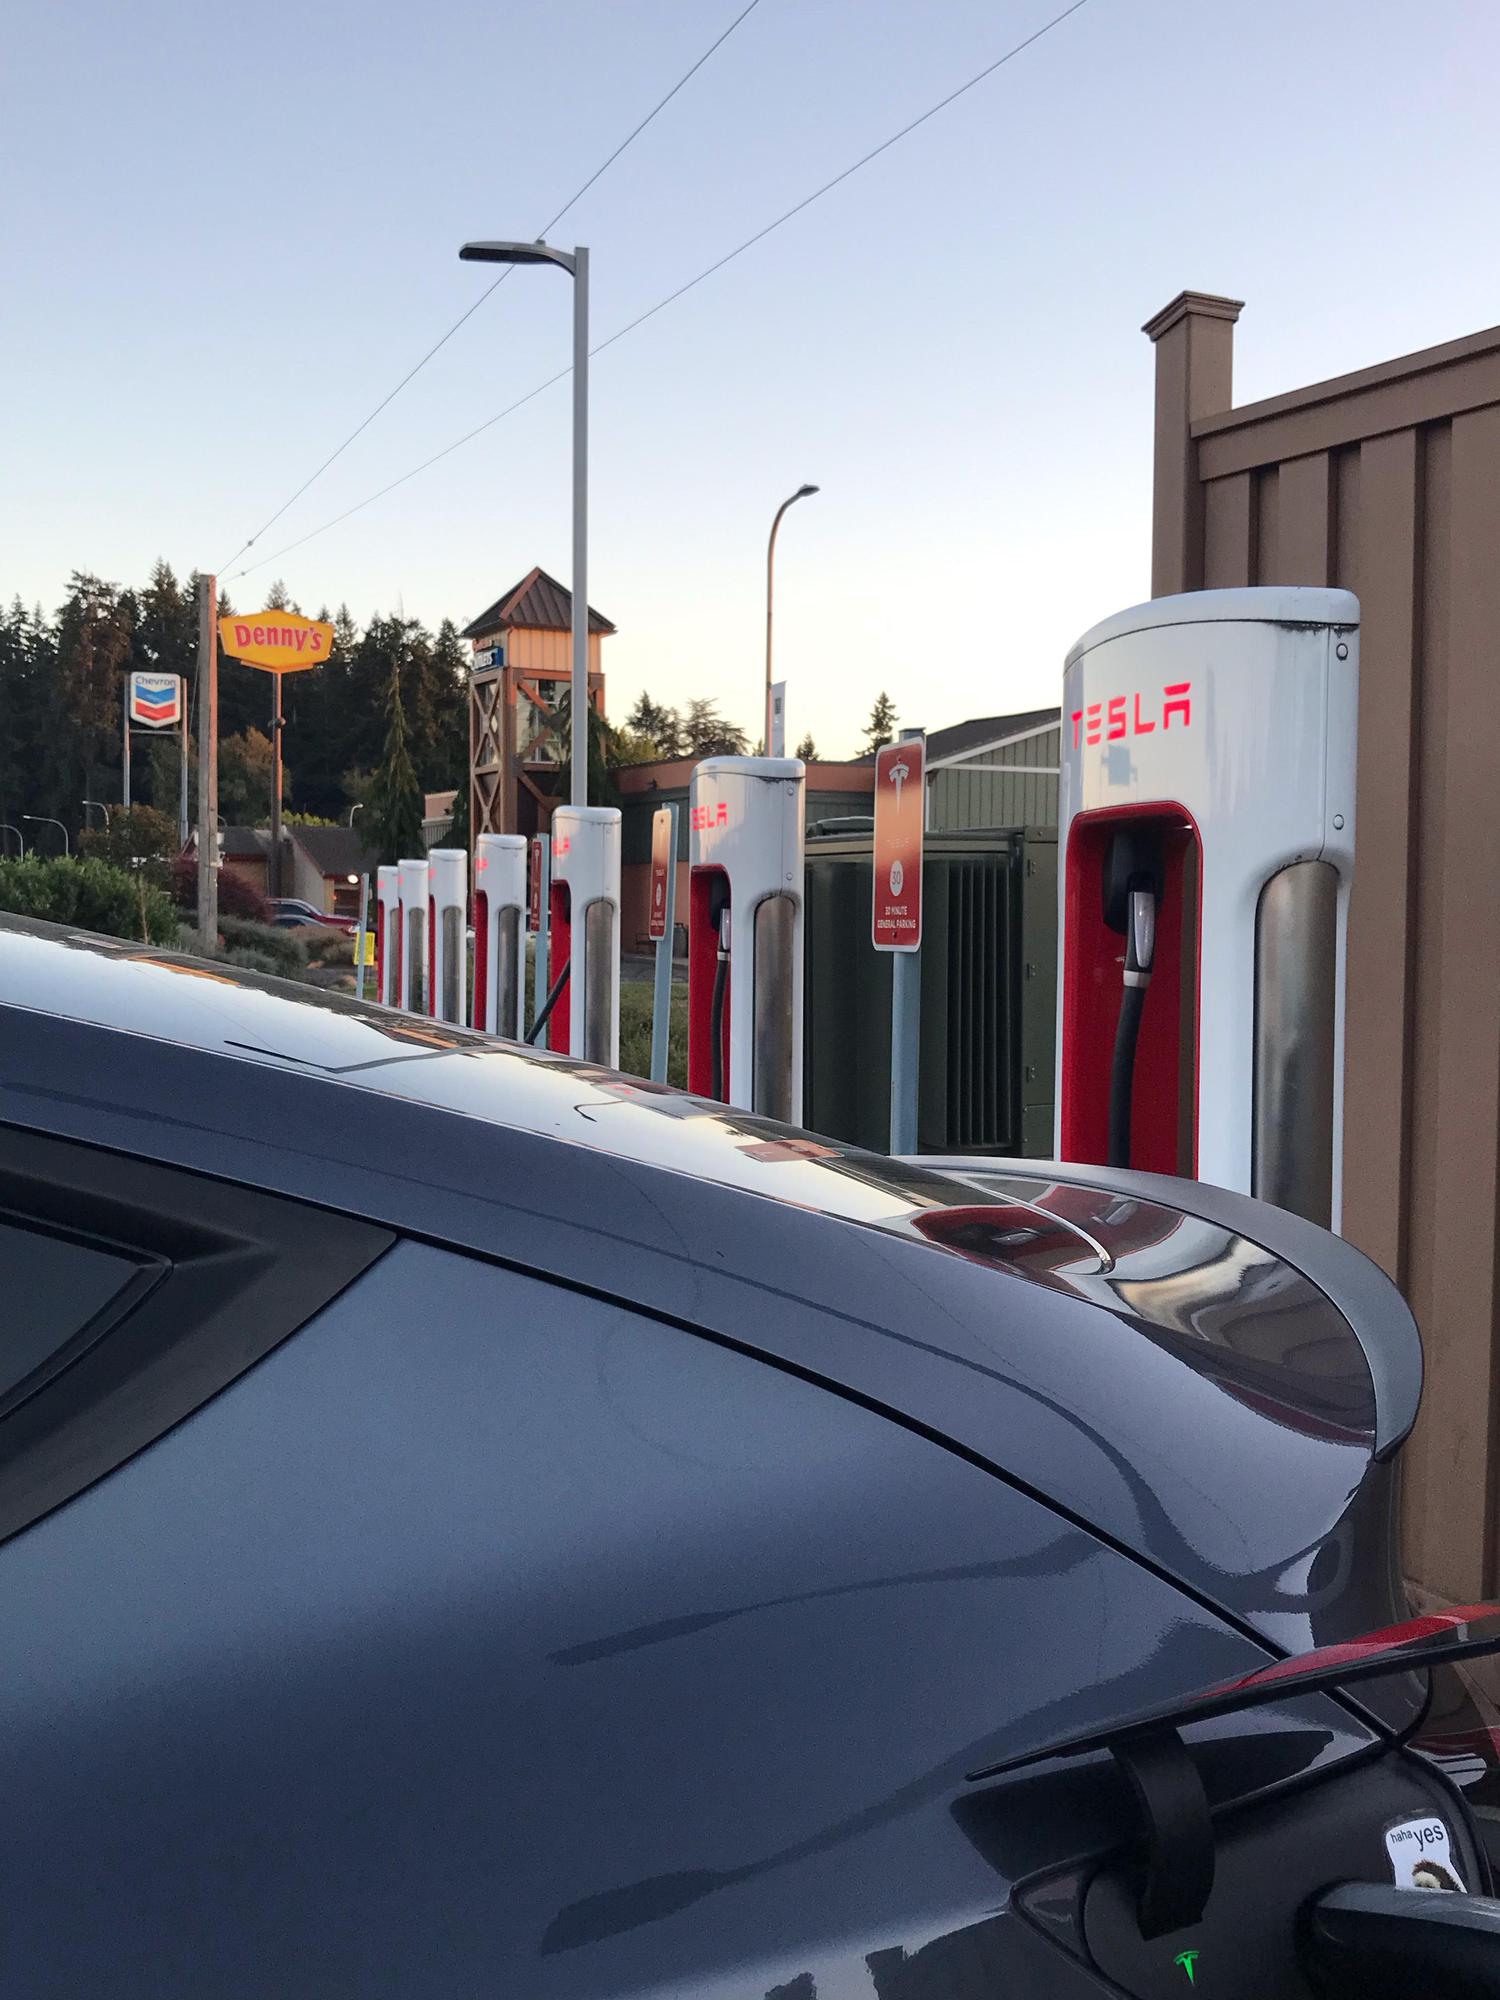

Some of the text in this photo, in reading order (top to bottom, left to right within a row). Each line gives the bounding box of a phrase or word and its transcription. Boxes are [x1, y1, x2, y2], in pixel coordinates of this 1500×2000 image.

[234, 624, 322, 652] Denny's
[135, 676, 176, 686] Chevron
[1071, 682, 1191, 751] TESLA
[691, 803, 728, 831] ESLA
[891, 871, 901, 885] 30
[877, 919, 916, 929] GENERAL PARKING
[1390, 1825, 1444, 1852] haha yes
